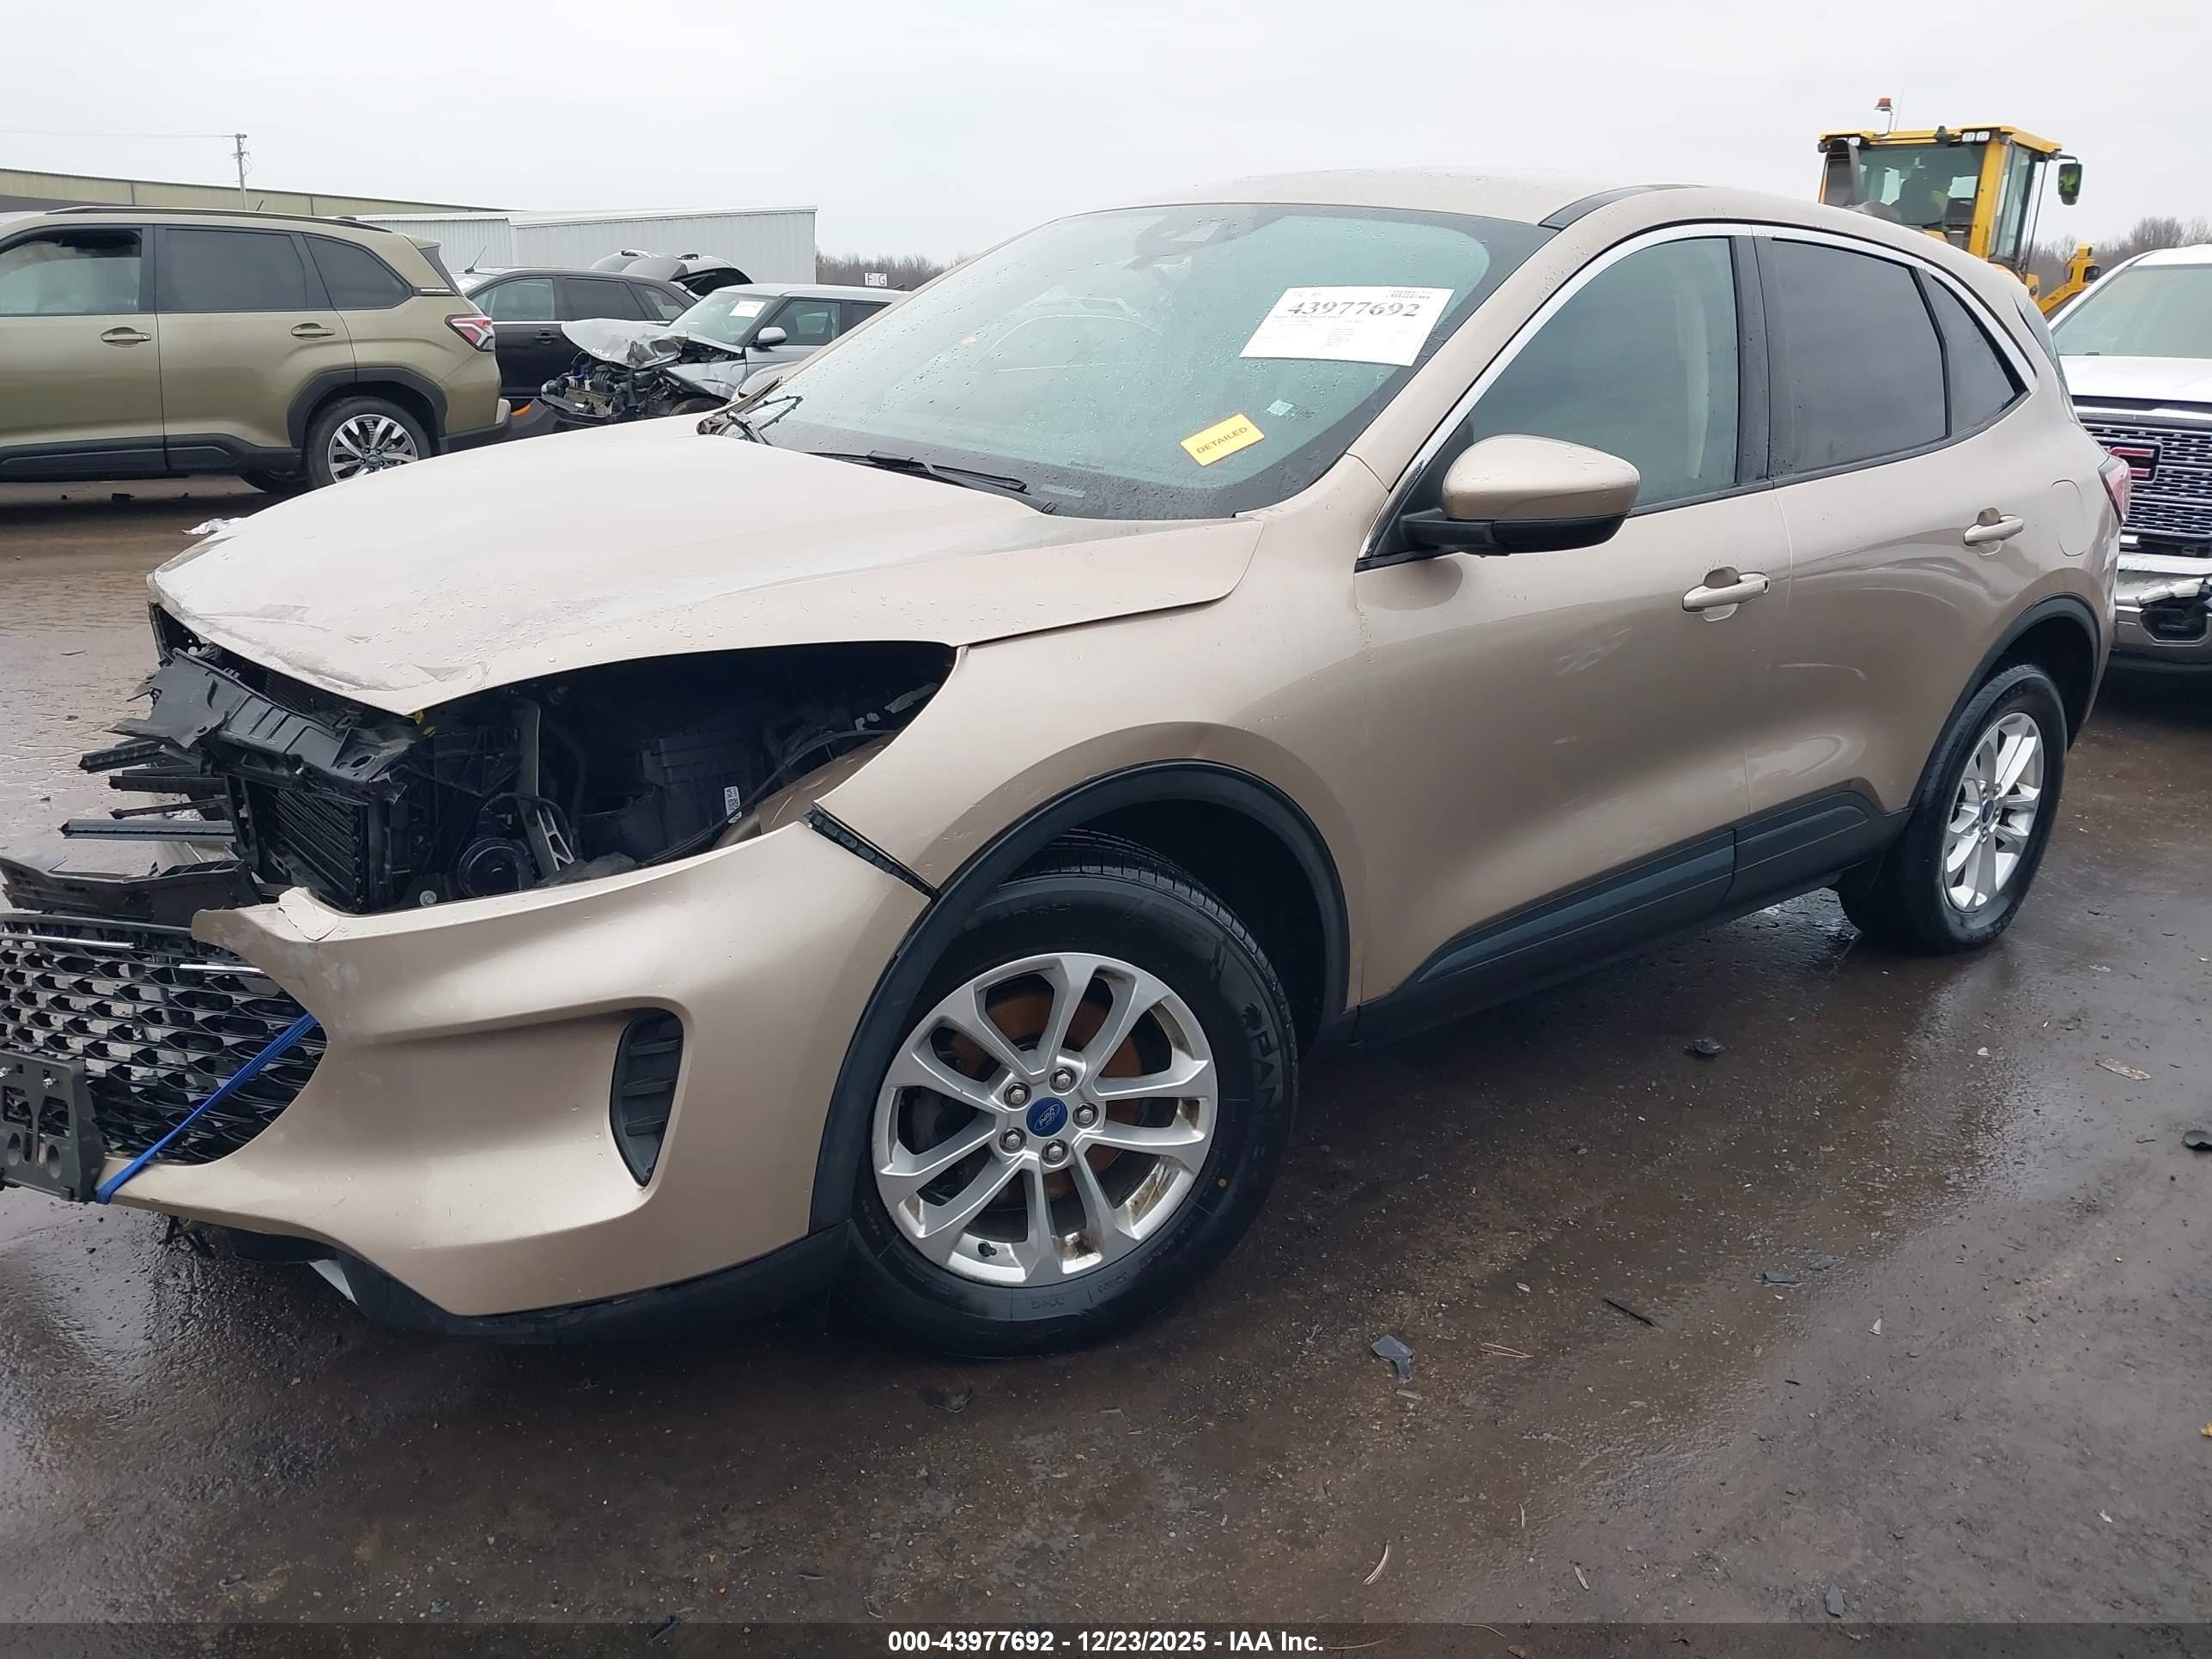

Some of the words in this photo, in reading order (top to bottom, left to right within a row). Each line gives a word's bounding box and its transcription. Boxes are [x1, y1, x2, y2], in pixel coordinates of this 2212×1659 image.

[867, 273, 873, 285] F
[878, 274, 886, 286] G
[1287, 301, 1420, 317] 43977692
[1195, 427, 1248, 453] DETAILED
[1039, 1108, 1057, 1127] Ford
